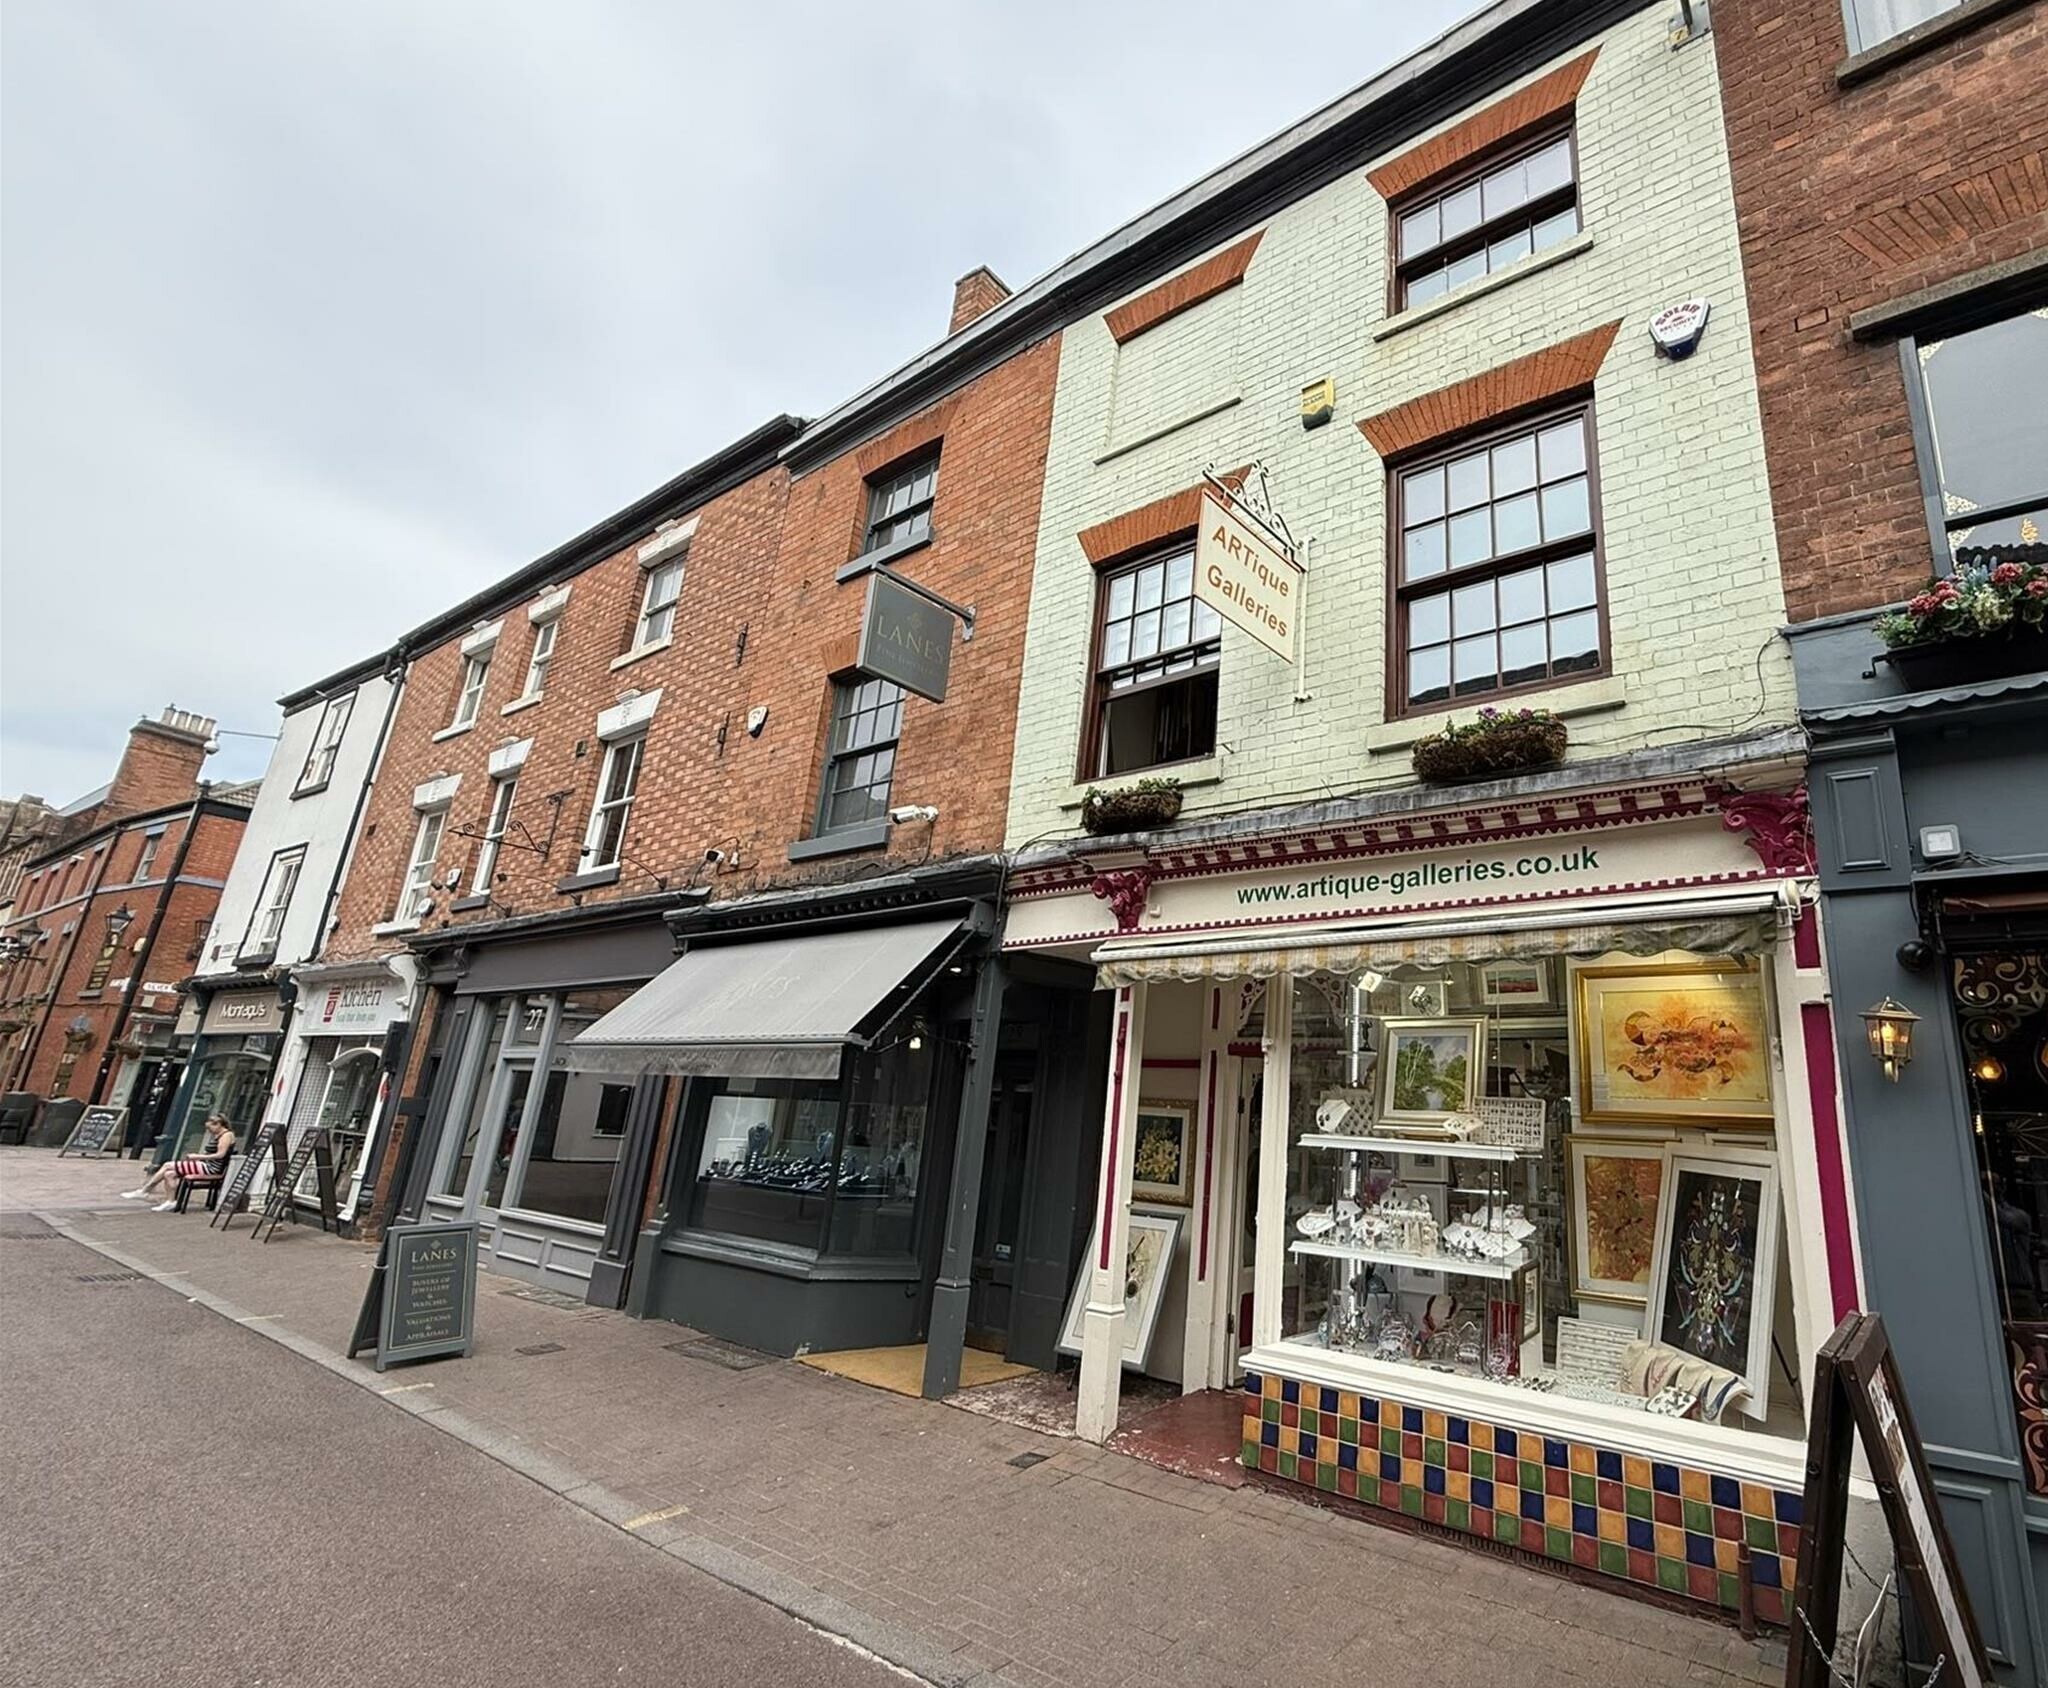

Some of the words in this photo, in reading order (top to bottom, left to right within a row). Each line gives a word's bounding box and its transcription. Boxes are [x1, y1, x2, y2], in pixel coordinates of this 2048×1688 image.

[1655, 304, 1701, 326] SOLAR
[1212, 525, 1289, 597] ARTique
[1207, 564, 1288, 637] Galleries
[877, 615, 945, 664] LANES
[1237, 846, 1600, 904] www.artique-galleries.co.uk
[525, 1008, 544, 1031] 27
[411, 1248, 457, 1263] LANES
